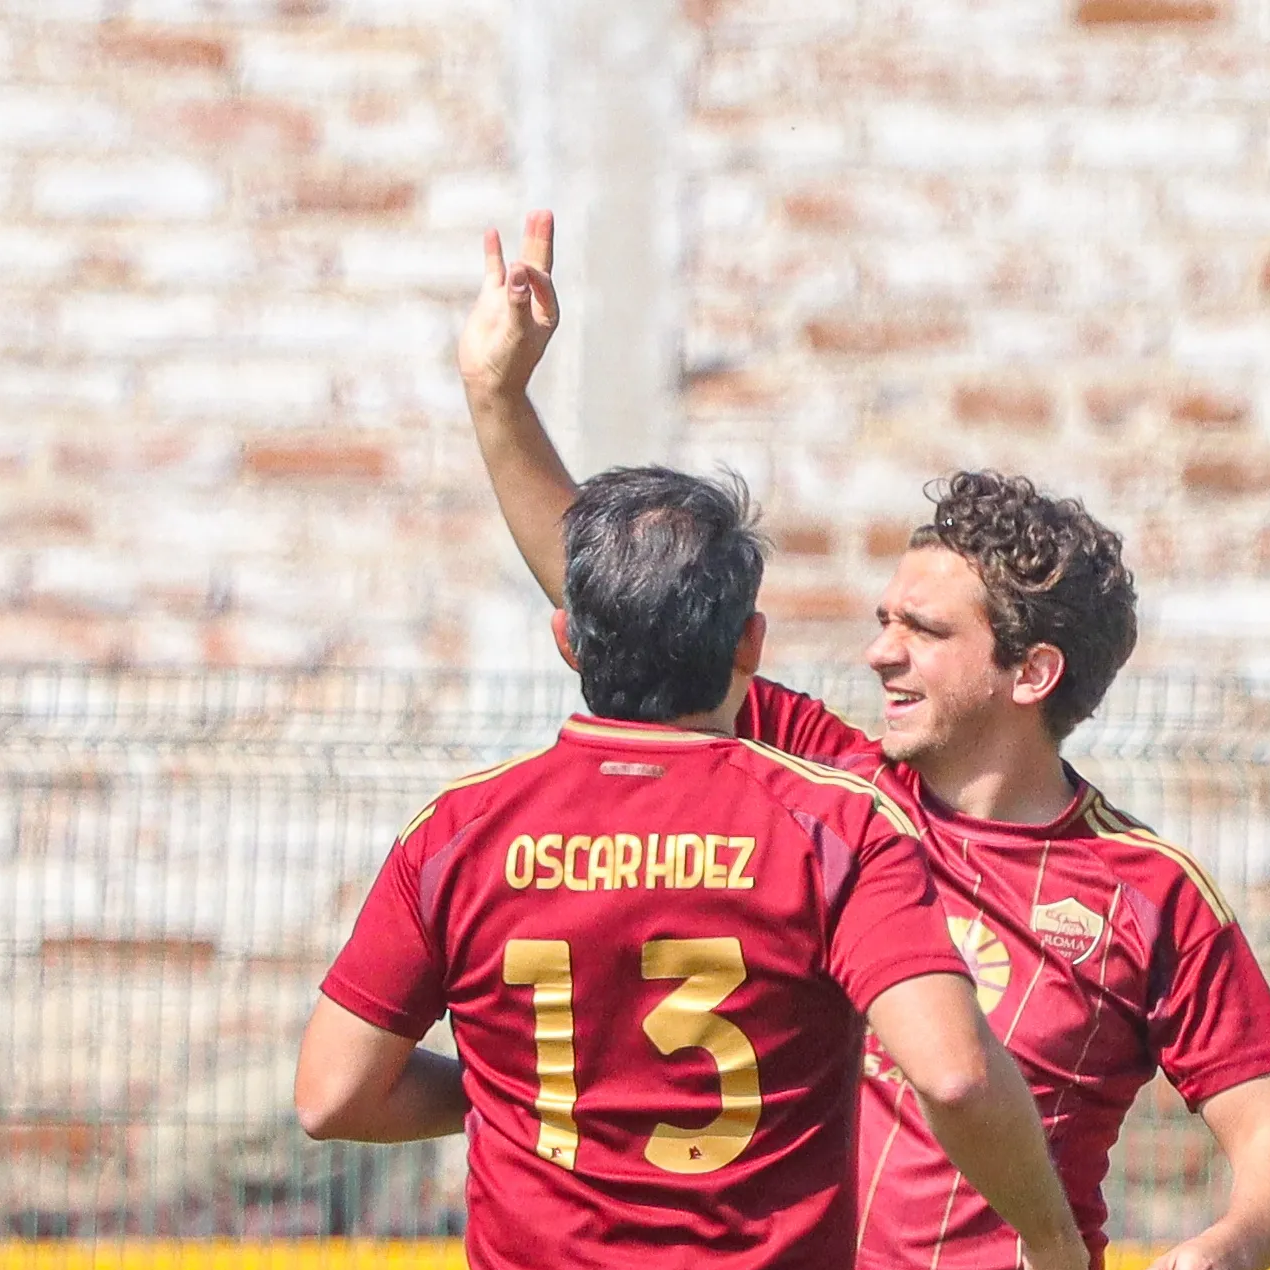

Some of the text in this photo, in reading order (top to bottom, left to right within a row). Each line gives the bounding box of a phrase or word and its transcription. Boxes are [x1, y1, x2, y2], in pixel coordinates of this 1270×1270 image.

[505, 833, 756, 891] OSCAR HDEZ
[1041, 934, 1086, 951] ROMA
[502, 936, 762, 1174] 13
